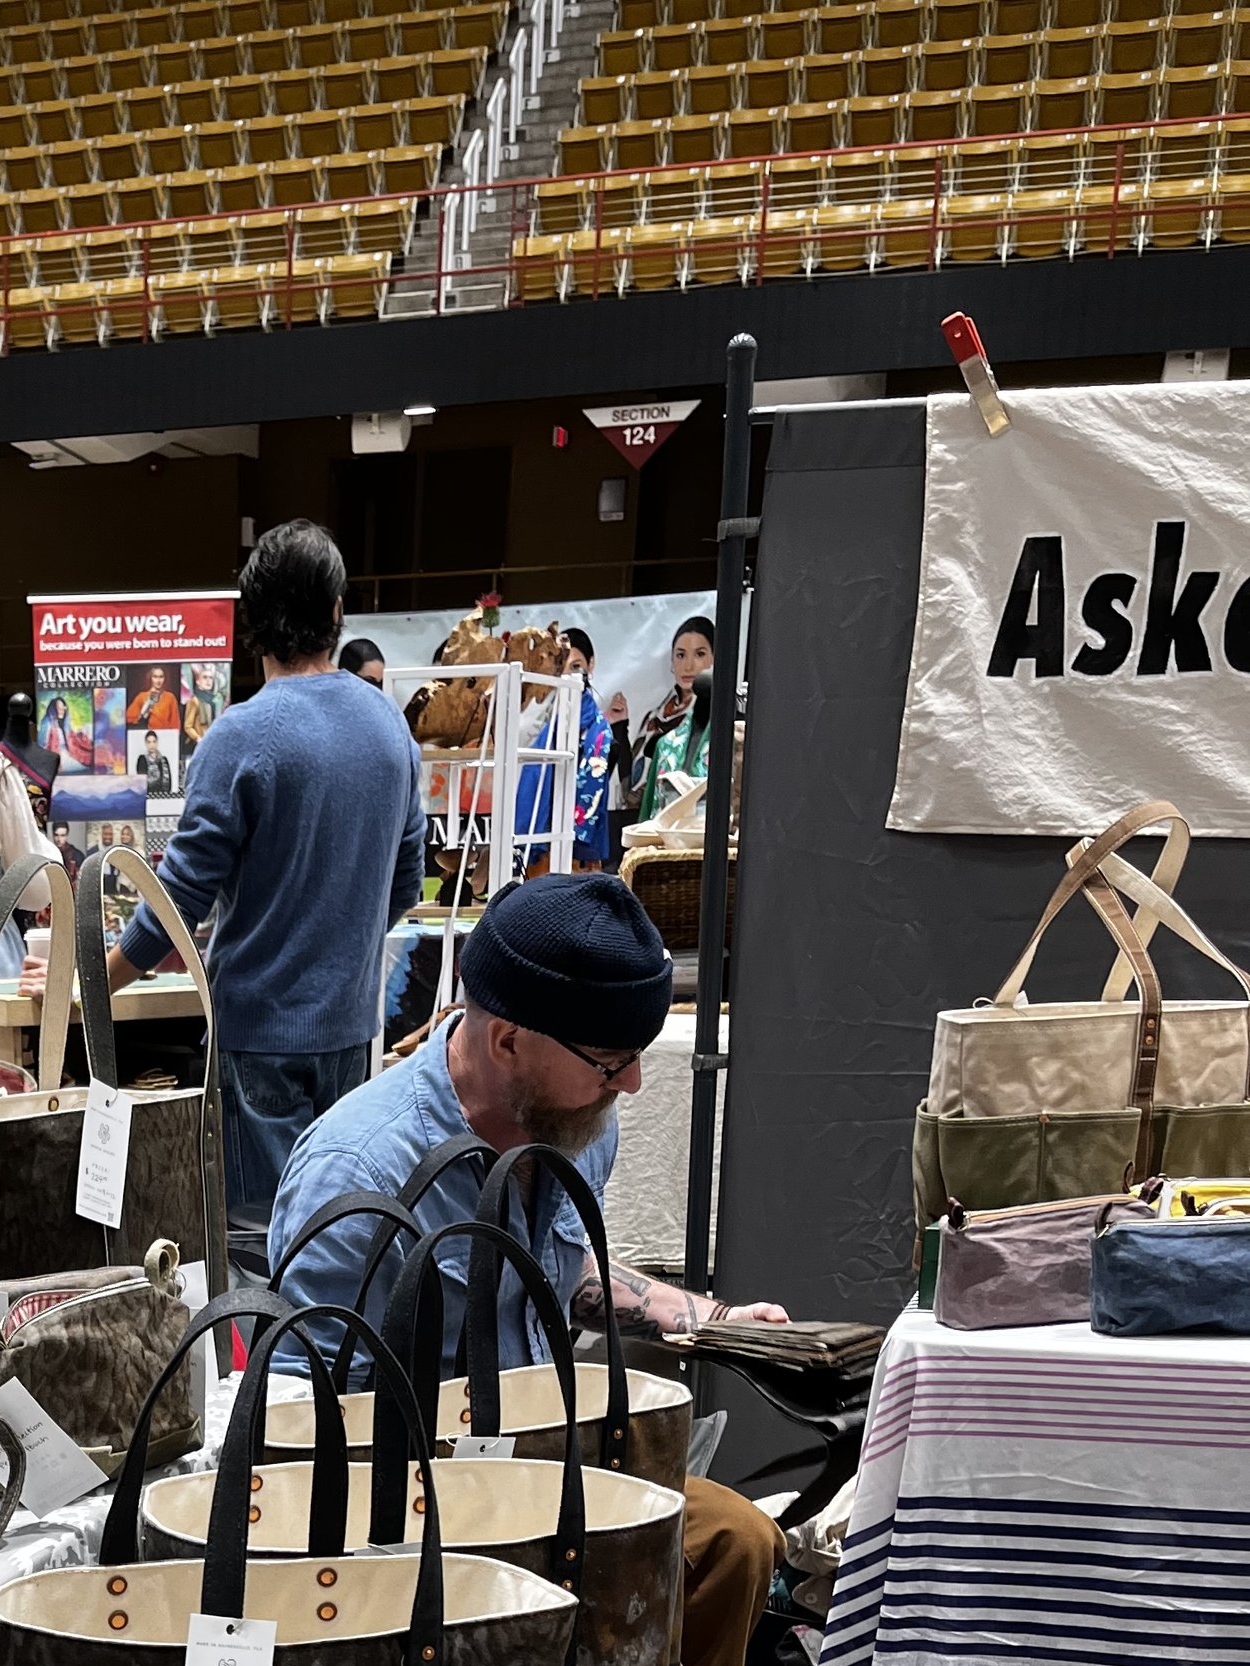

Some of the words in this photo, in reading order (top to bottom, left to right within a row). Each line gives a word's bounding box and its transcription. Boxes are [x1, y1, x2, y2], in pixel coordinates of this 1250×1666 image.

[611, 406, 670, 422] SECTION
[623, 425, 656, 446] 124
[39, 612, 77, 635] Art
[78, 616, 122, 640] you
[124, 614, 186, 635] wear,
[39, 640, 83, 652] because
[83, 641, 105, 653] you
[105, 640, 132, 649] were
[132, 637, 159, 649] born
[160, 637, 173, 648] to
[173, 635, 204, 648] stand
[204, 635, 227, 647] out!
[37, 665, 121, 683] MARRERO
